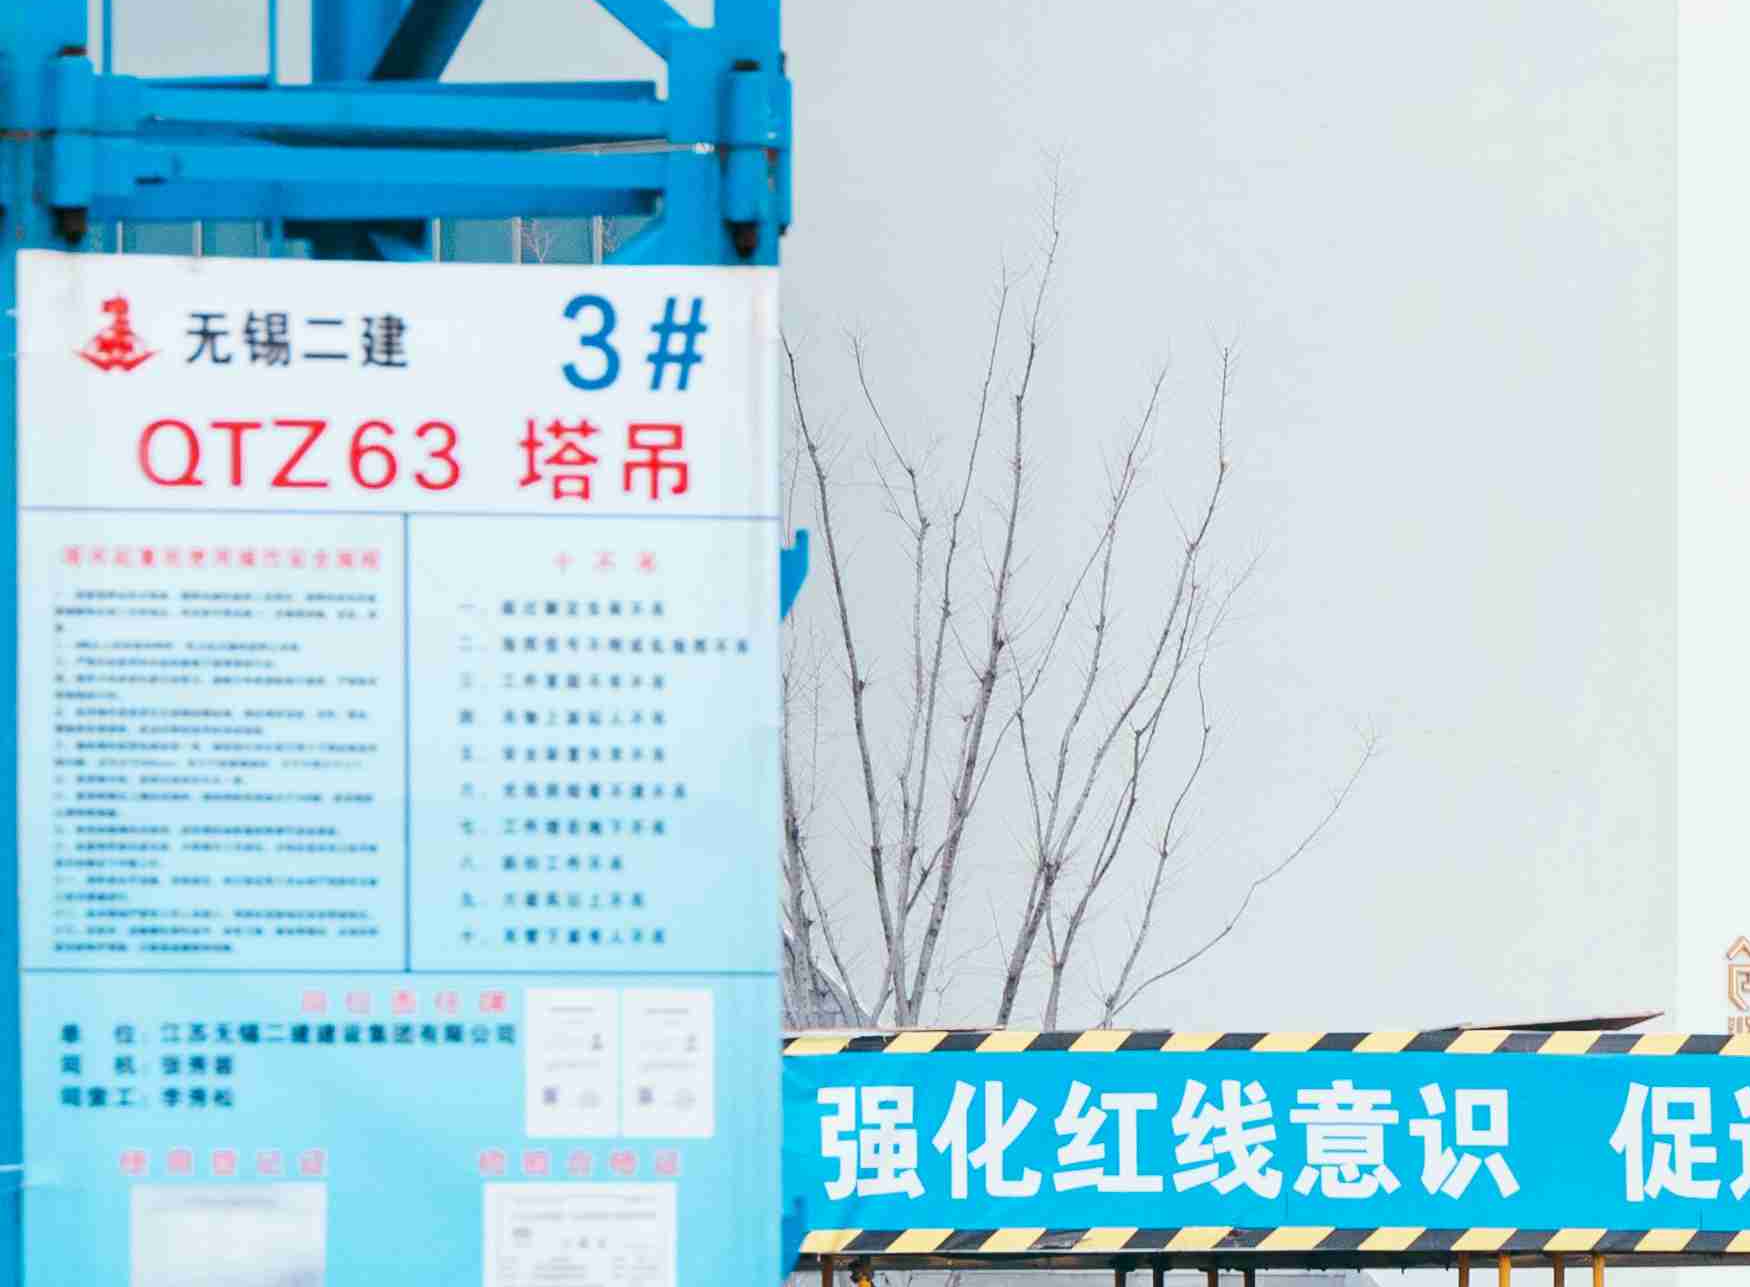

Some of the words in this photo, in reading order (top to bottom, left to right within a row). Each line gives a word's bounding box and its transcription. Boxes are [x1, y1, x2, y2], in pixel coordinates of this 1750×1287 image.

[185, 310, 411, 370] 无锡二建
[560, 292, 708, 393] 3#
[137, 418, 463, 491] QTZ63
[520, 418, 691, 503] 塔吊
[817, 1079, 1515, 1200] 强化红线意识
